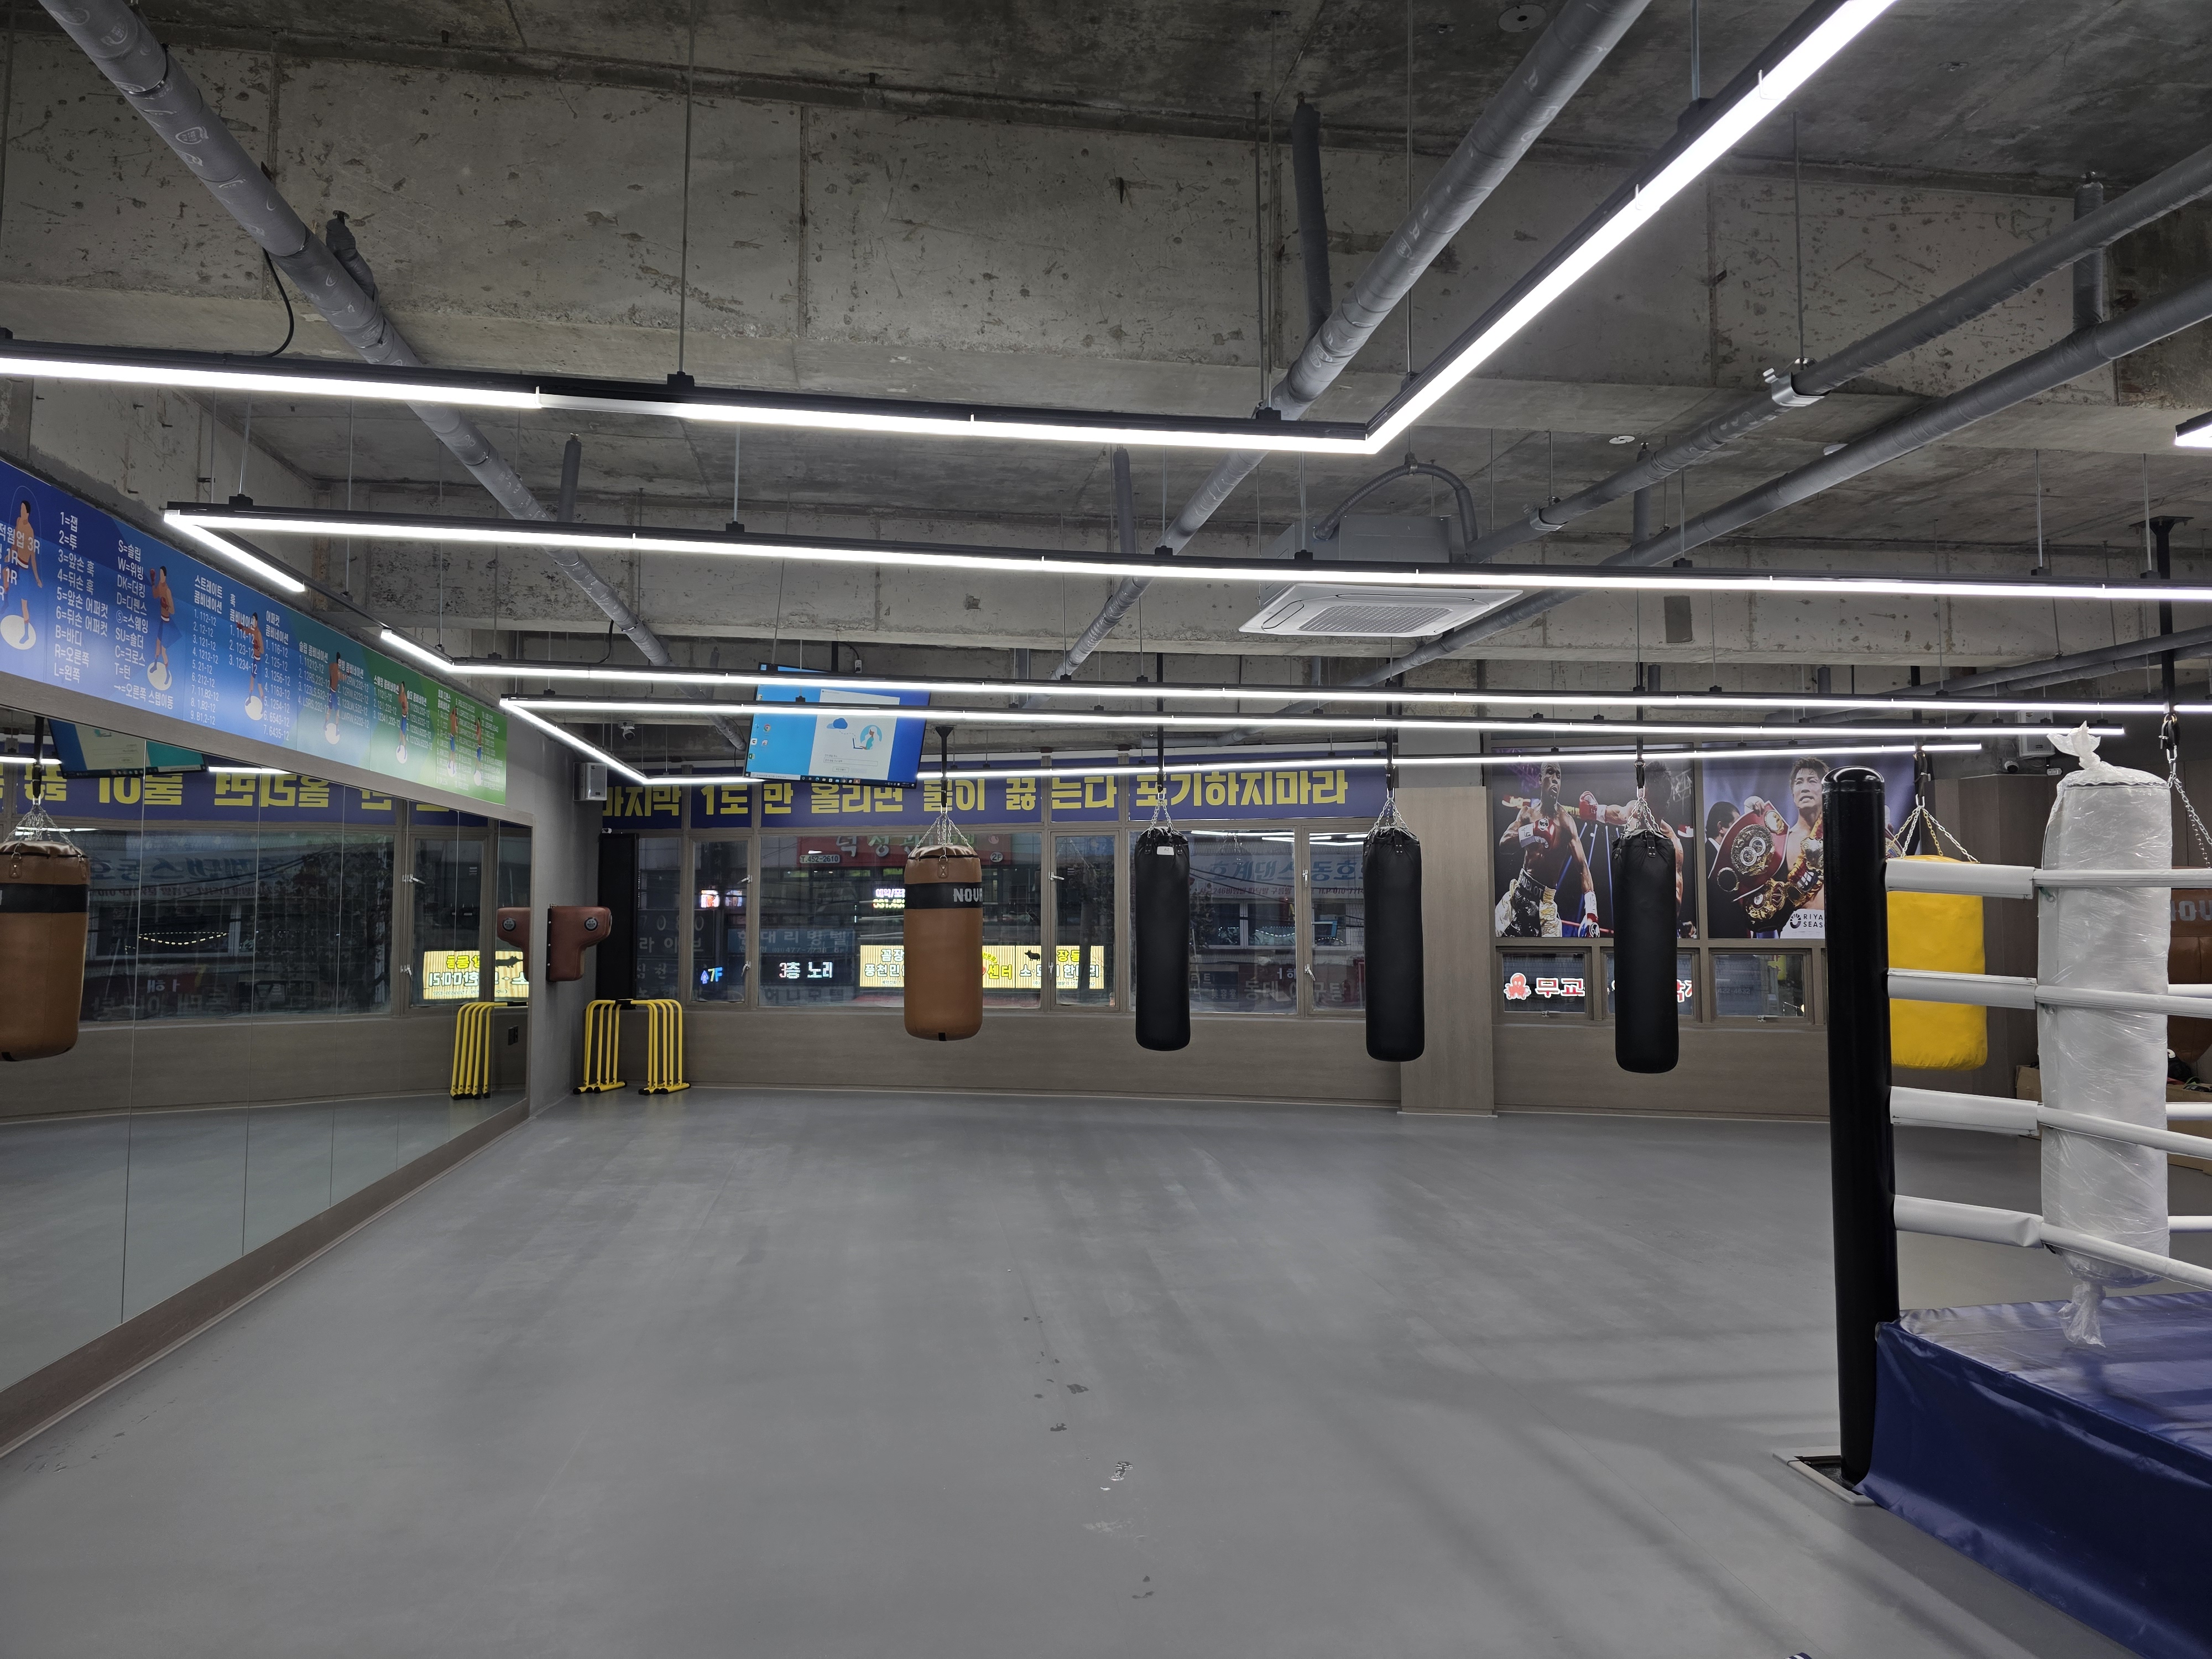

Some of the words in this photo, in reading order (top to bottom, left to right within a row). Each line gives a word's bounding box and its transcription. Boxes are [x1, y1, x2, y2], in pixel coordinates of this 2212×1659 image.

[60, 512, 77, 532] 1=잽
[28, 537, 40, 554] 3R
[59, 530, 77, 550] 2=투
[7, 549, 18, 565] 1R
[118, 539, 140, 562] S=슬립
[58, 549, 84, 572] 3=앞손
[87, 560, 94, 577] 훅
[118, 556, 143, 580] W=위빙
[6, 568, 17, 585] 1R
[86, 579, 93, 595] 훅
[117, 575, 145, 598] DK=더킹
[195, 575, 222, 598] 스트레이트
[57, 587, 83, 609] 5=앞손
[86, 597, 108, 619] 어퍼컷
[117, 592, 147, 615] D=디펜스
[195, 590, 222, 614] 콤비네이션
[230, 593, 236, 607] 훅
[86, 615, 107, 637] 어퍼컷
[200, 611, 216, 626] 112-12
[266, 611, 280, 627] 어퍼컷
[56, 624, 82, 646] B=바디
[116, 627, 143, 649] SU=숄더
[200, 624, 213, 637] 12-12
[236, 628, 254, 644] 114-12
[266, 624, 288, 645] 콤비네이션
[199, 637, 216, 651] 121-12
[236, 642, 254, 659] 123-12
[272, 643, 288, 658] 116-12
[55, 644, 89, 667] R=오른쪽
[115, 645, 145, 666] C=크로스
[199, 649, 218, 664] 1212-12
[272, 656, 288, 671] 125-12
[54, 662, 80, 683] L=왼쪽
[114, 662, 131, 680] T=턴
[199, 662, 212, 675] 21-12
[236, 657, 257, 675] 1234-12
[198, 674, 215, 688] 212-12
[271, 670, 290, 686] 1256-12
[148, 690, 173, 709] 스텝이동
[270, 698, 290, 713] 1254-12
[270, 712, 289, 727] 6543-12
[269, 726, 289, 741] 6435-12
[603, 785, 681, 816] 마지막
[1136, 770, 1348, 806] 포기하지마라
[1210, 860, 1363, 881] 호계댄스동호
[707, 967, 723, 982] 7F
[779, 962, 800, 979] 3층
[864, 964, 904, 977] 풍천민
[987, 964, 1012, 980] 센터
